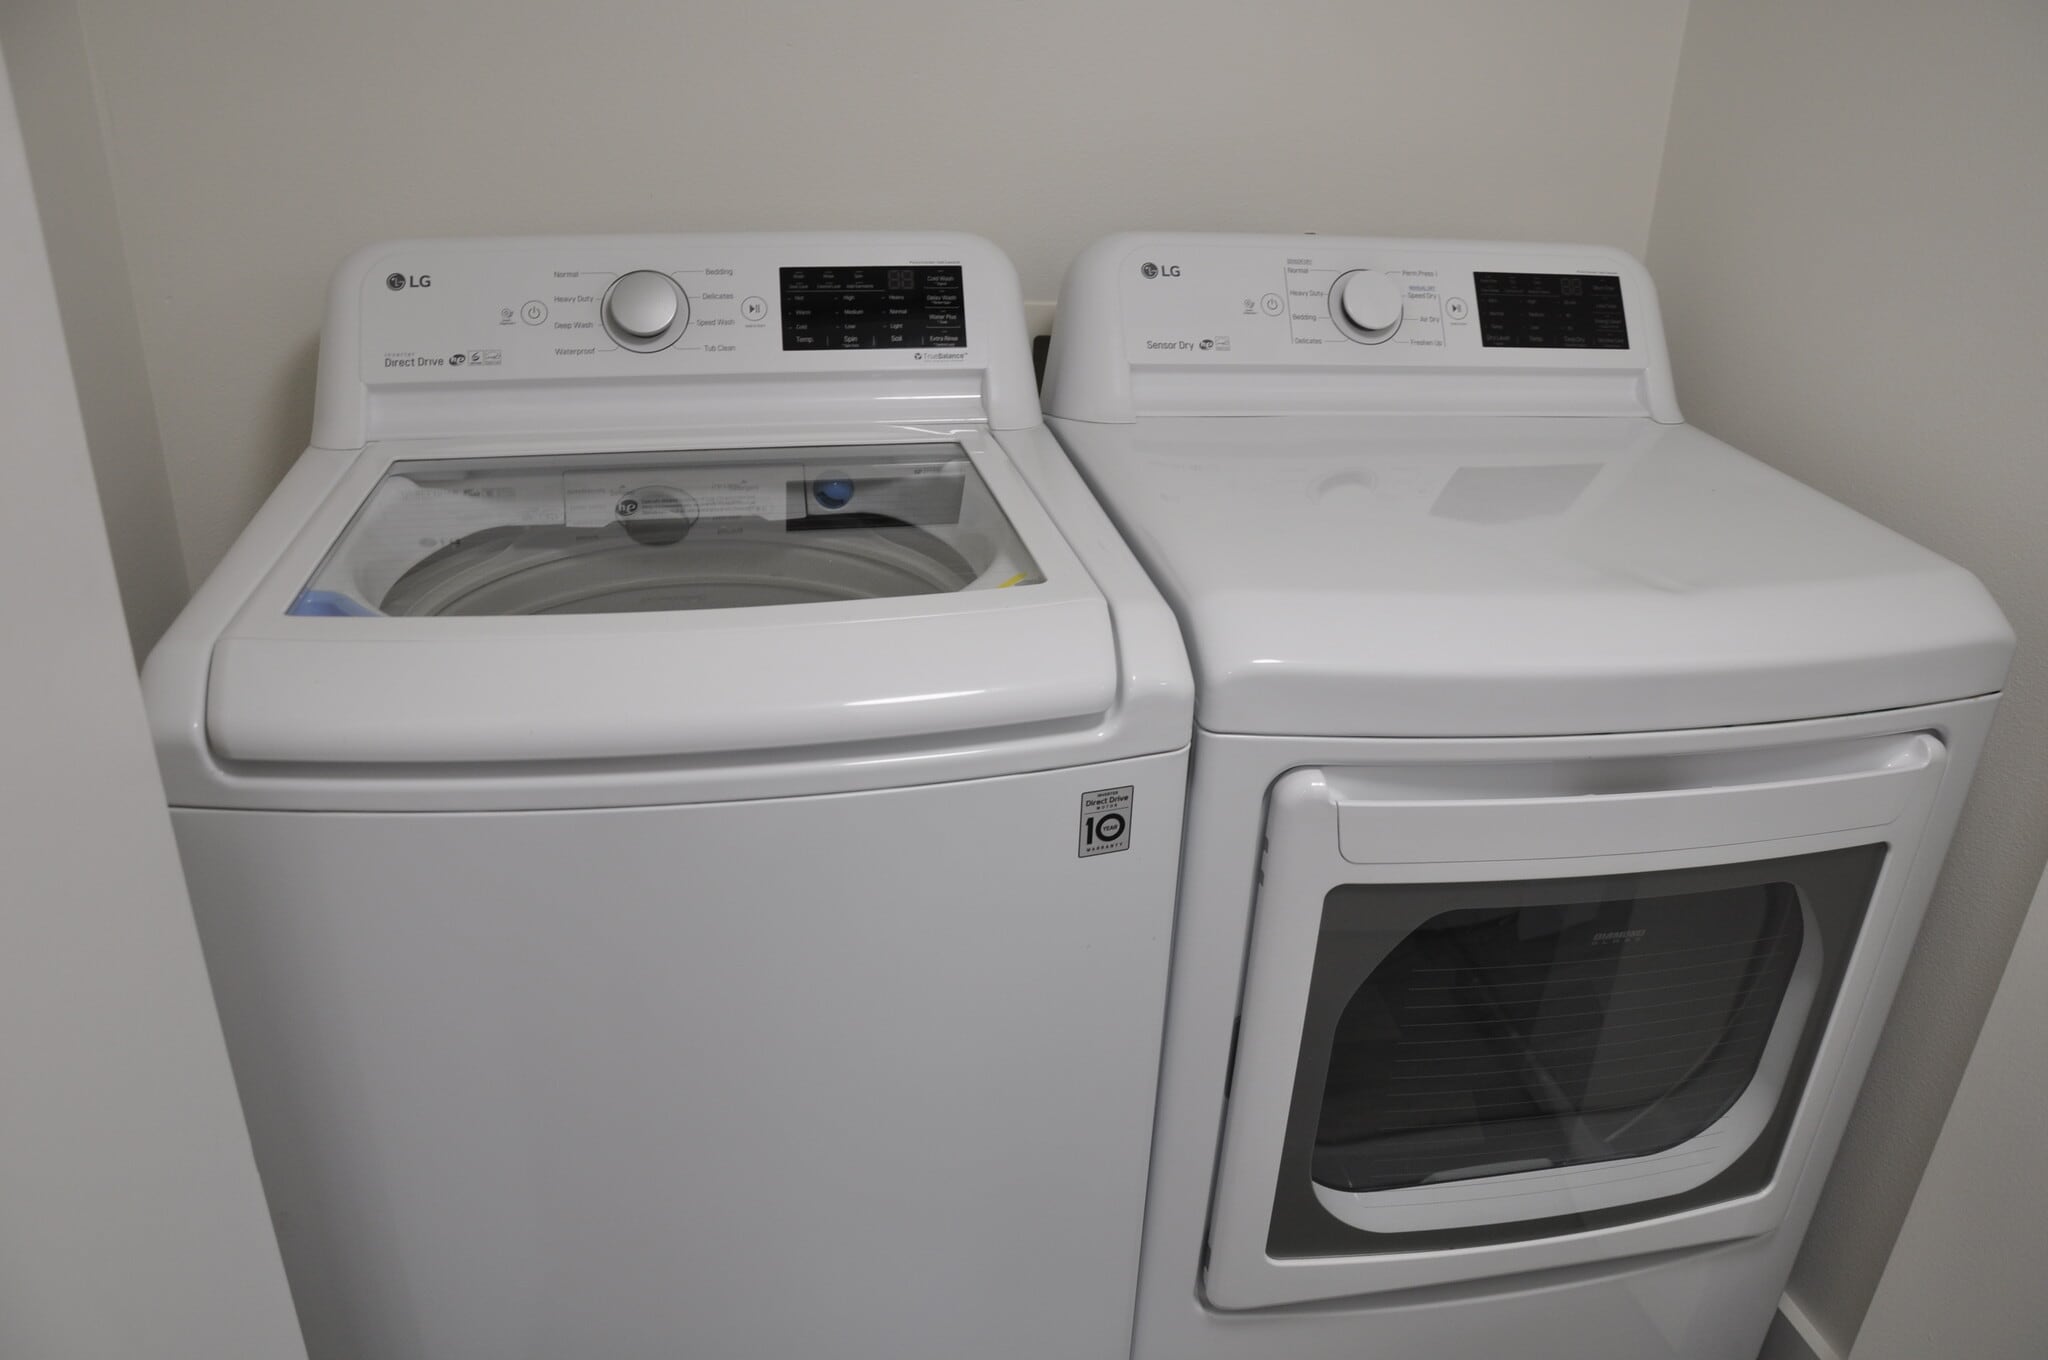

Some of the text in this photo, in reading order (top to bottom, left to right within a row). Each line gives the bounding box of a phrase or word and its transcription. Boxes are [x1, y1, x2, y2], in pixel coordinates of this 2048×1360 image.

[1161, 265, 1180, 277] LG
[410, 275, 431, 288] LG
[1146, 341, 1194, 351] Sensor Dry
[384, 357, 444, 367] Direct Drive
[1086, 798, 1107, 807] Direct
[1086, 813, 1125, 845] 10
